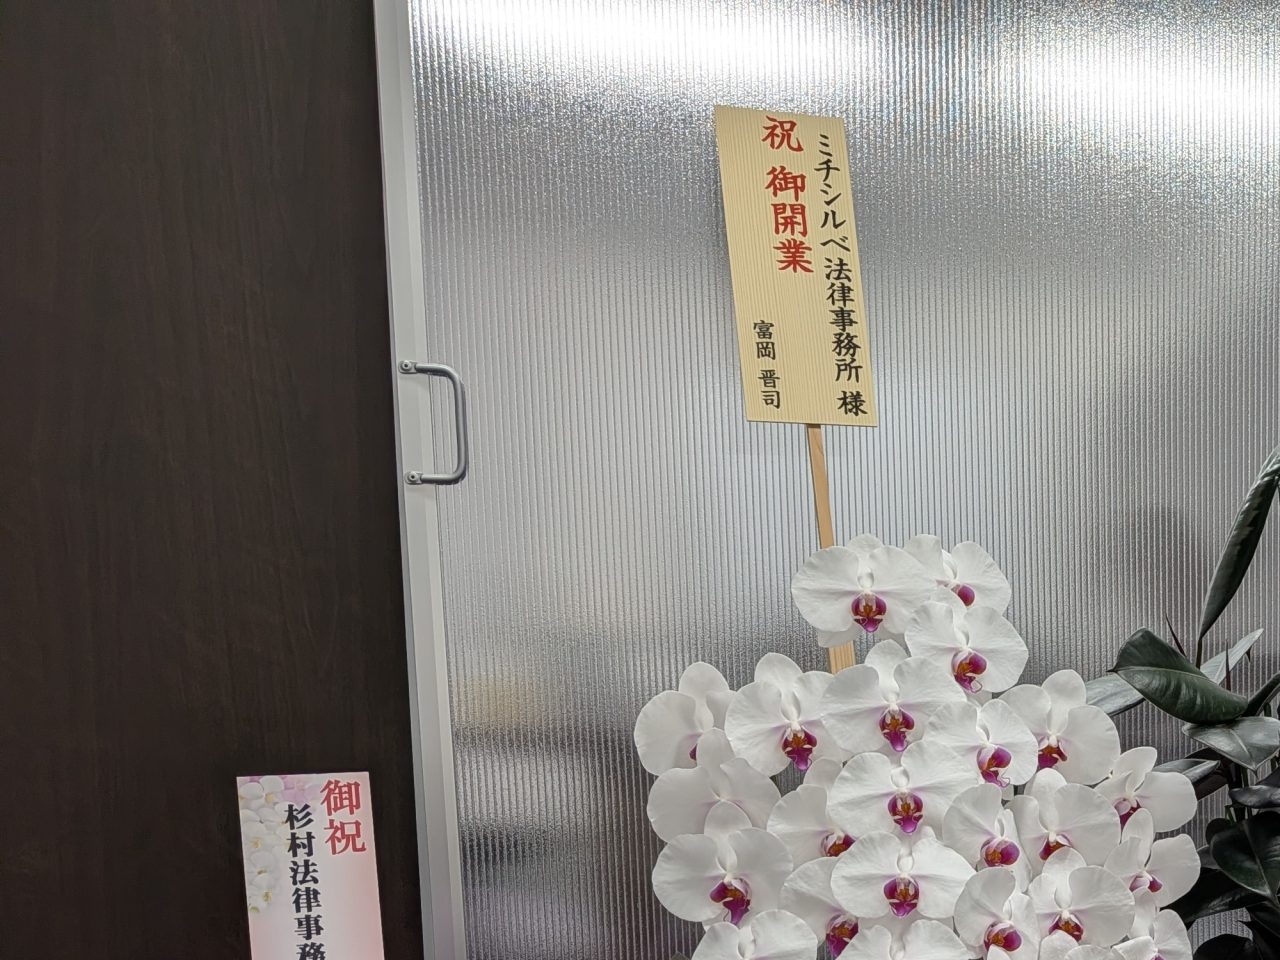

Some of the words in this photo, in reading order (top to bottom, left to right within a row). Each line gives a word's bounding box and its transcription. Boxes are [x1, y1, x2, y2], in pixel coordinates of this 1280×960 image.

[761, 115, 804, 152] 祝
[765, 165, 814, 274] 御開業
[753, 319, 776, 361] 富岡
[758, 369, 781, 410] 晋司
[836, 390, 868, 417] 様
[320, 779, 367, 856] 御祝
